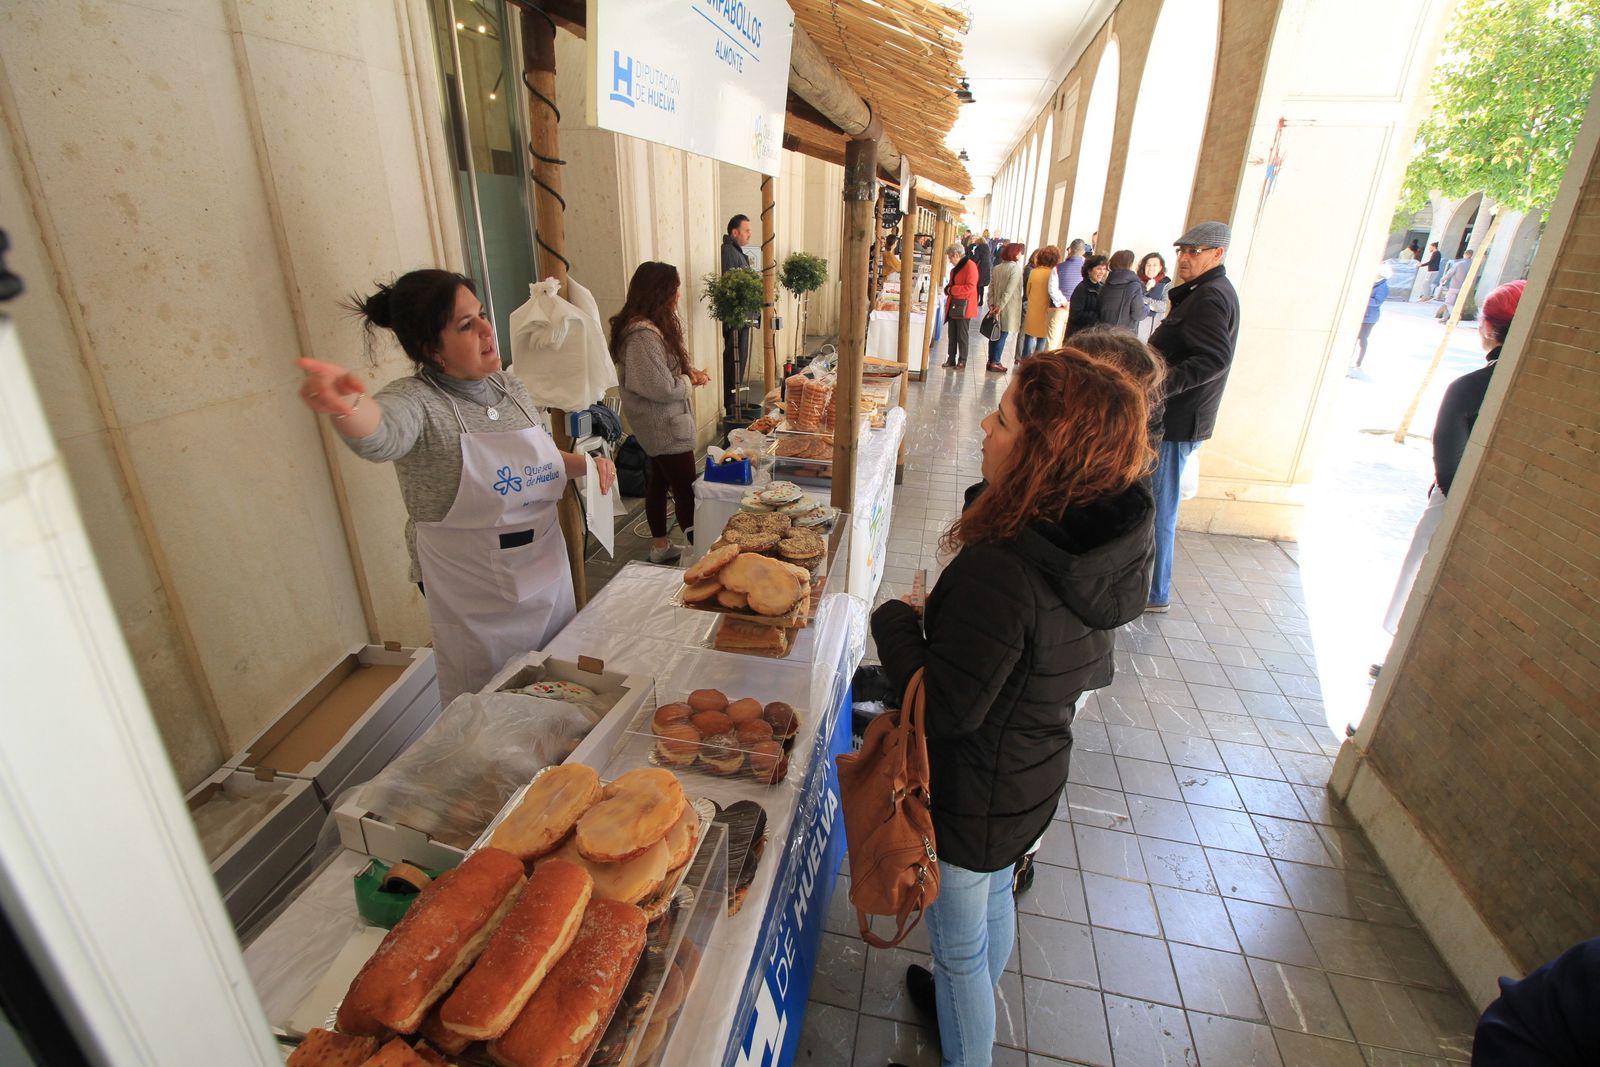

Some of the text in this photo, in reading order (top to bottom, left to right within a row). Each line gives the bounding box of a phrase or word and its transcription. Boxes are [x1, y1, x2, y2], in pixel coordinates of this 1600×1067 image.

[715, 37, 743, 74] ALMONTE
[635, 82, 676, 113] DE HUELVA
[524, 466, 542, 476] Que
[526, 471, 560, 487] de Huelva
[775, 926, 796, 1002] DE
[793, 786, 839, 933] HUELVA
